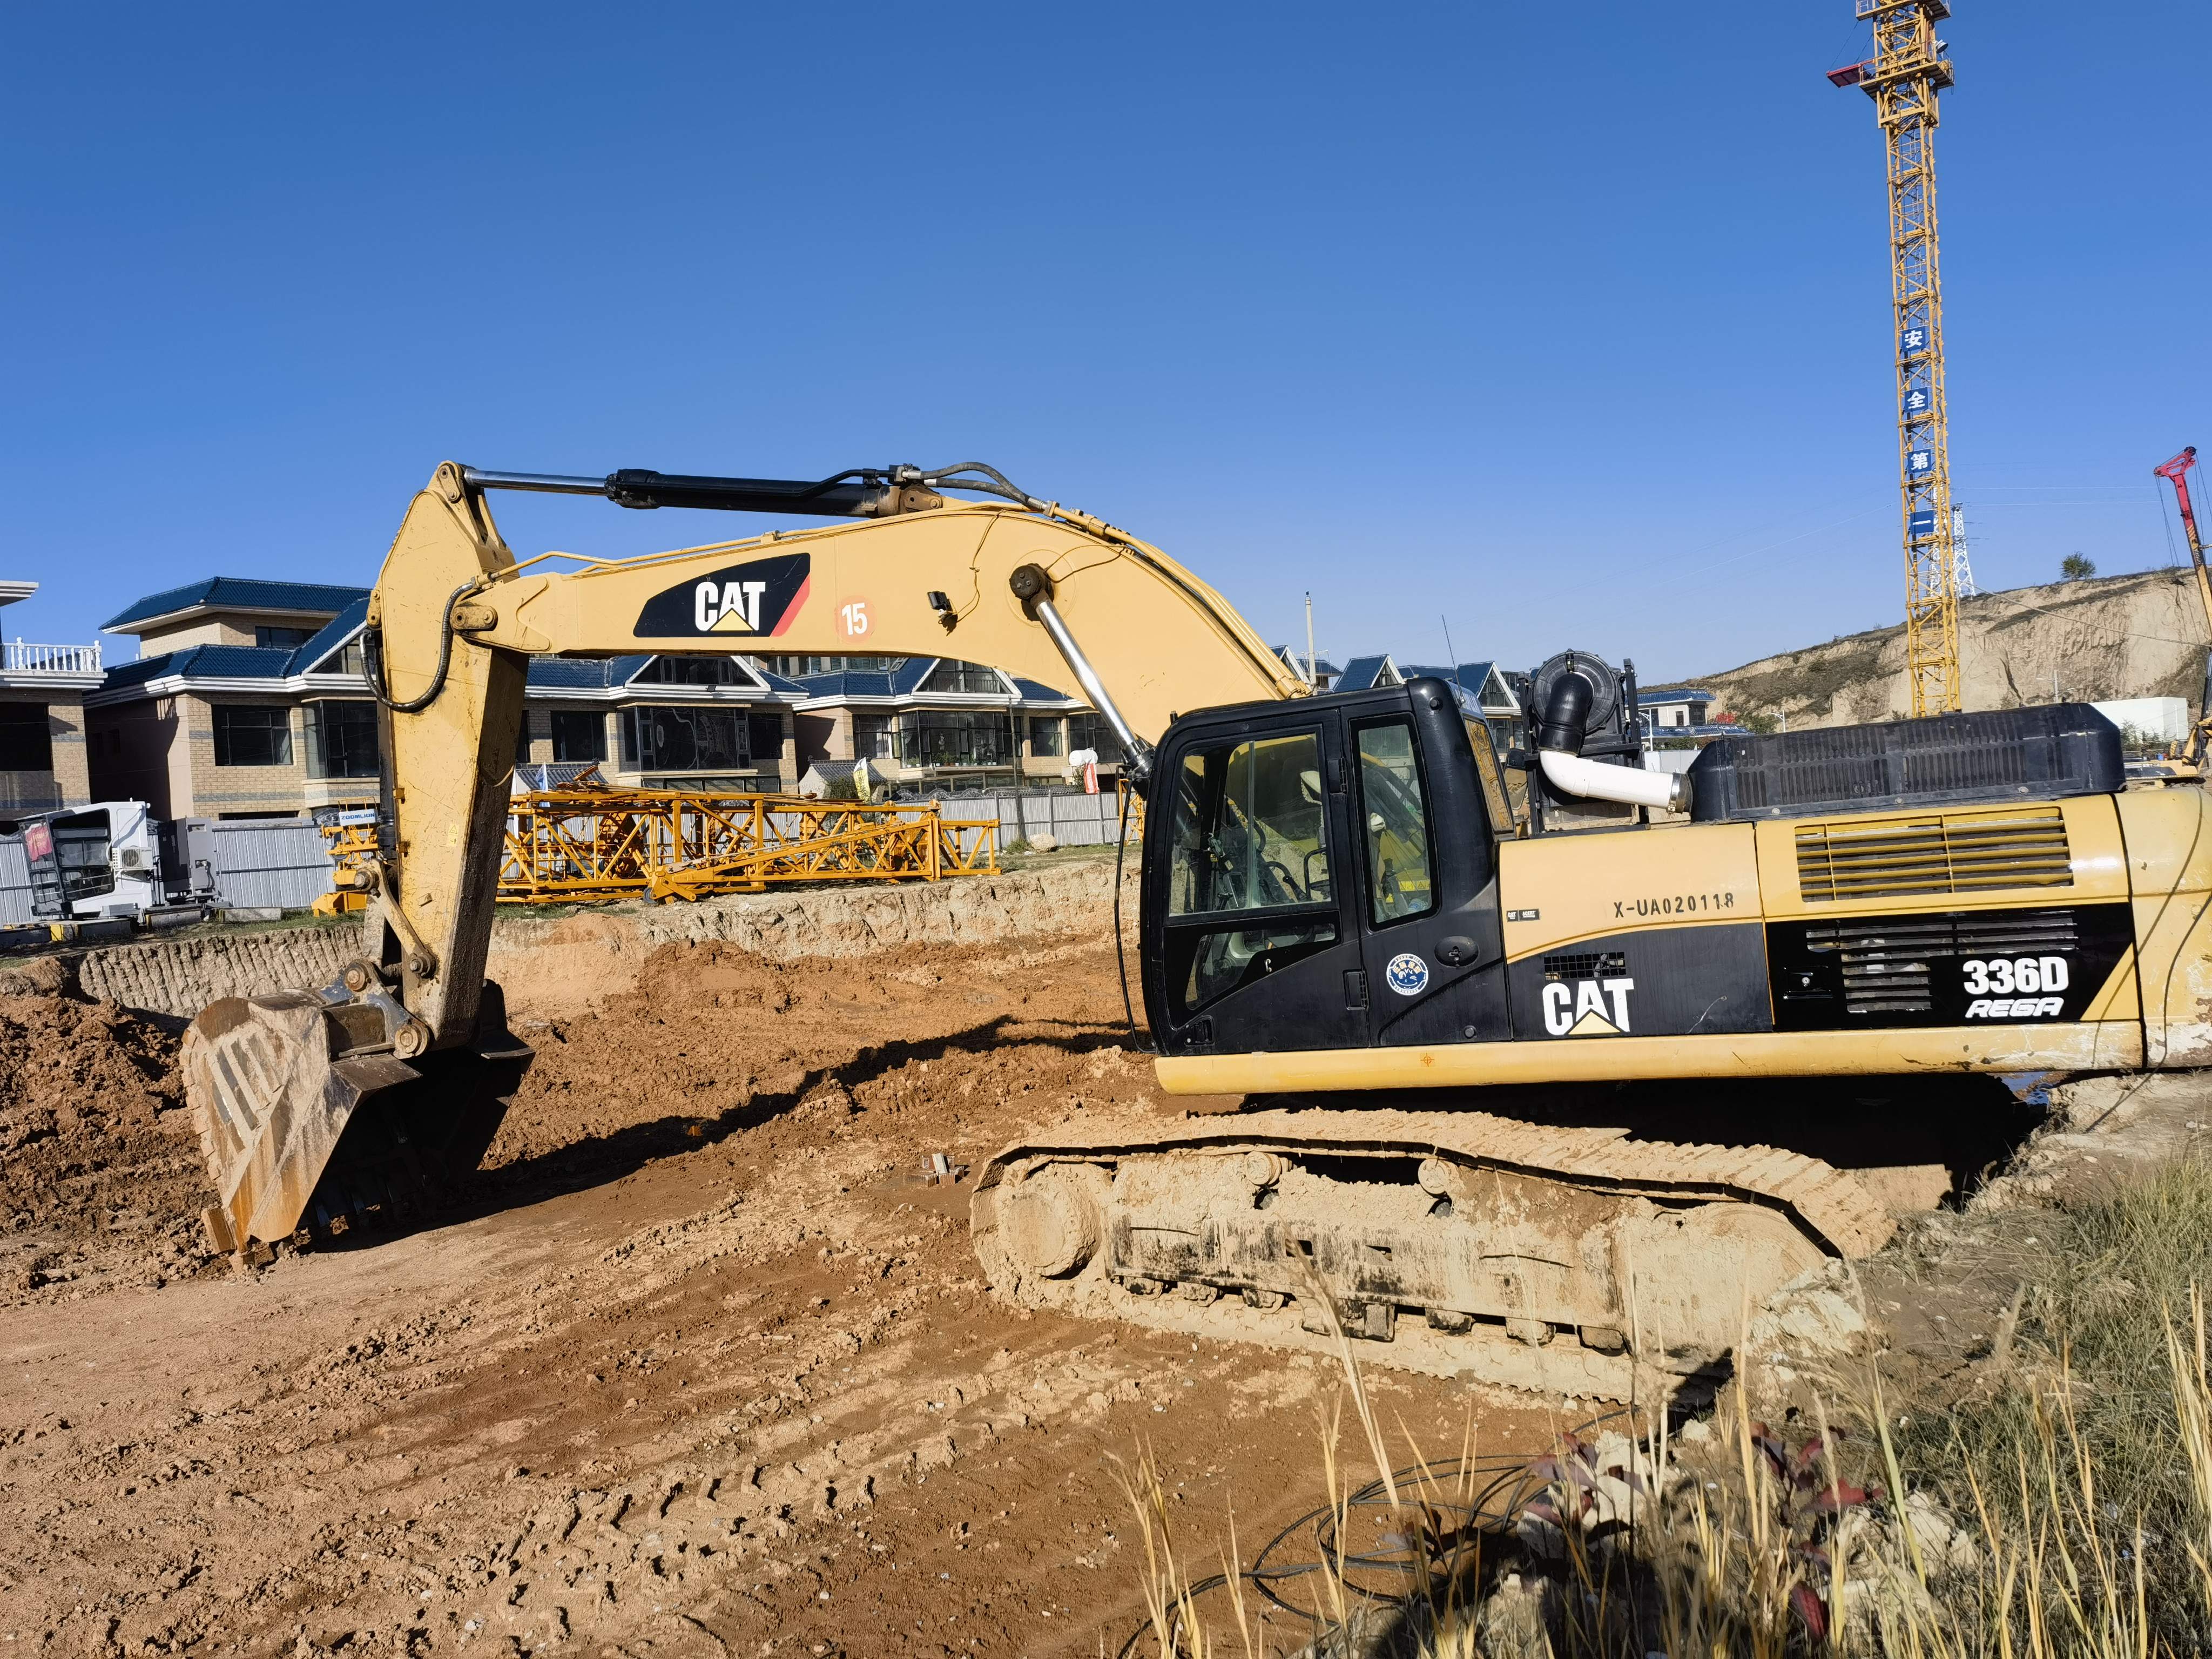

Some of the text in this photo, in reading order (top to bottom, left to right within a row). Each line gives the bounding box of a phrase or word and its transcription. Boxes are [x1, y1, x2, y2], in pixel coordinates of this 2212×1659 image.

[1904, 330, 1931, 525] 安全第一
[695, 581, 766, 631] CAT
[841, 602, 868, 635] 15
[1614, 892, 1734, 918] X-UA020118
[1963, 956, 2069, 994] 336D
[1542, 978, 1634, 1035] CAT
[1965, 997, 2064, 1018] REGA
